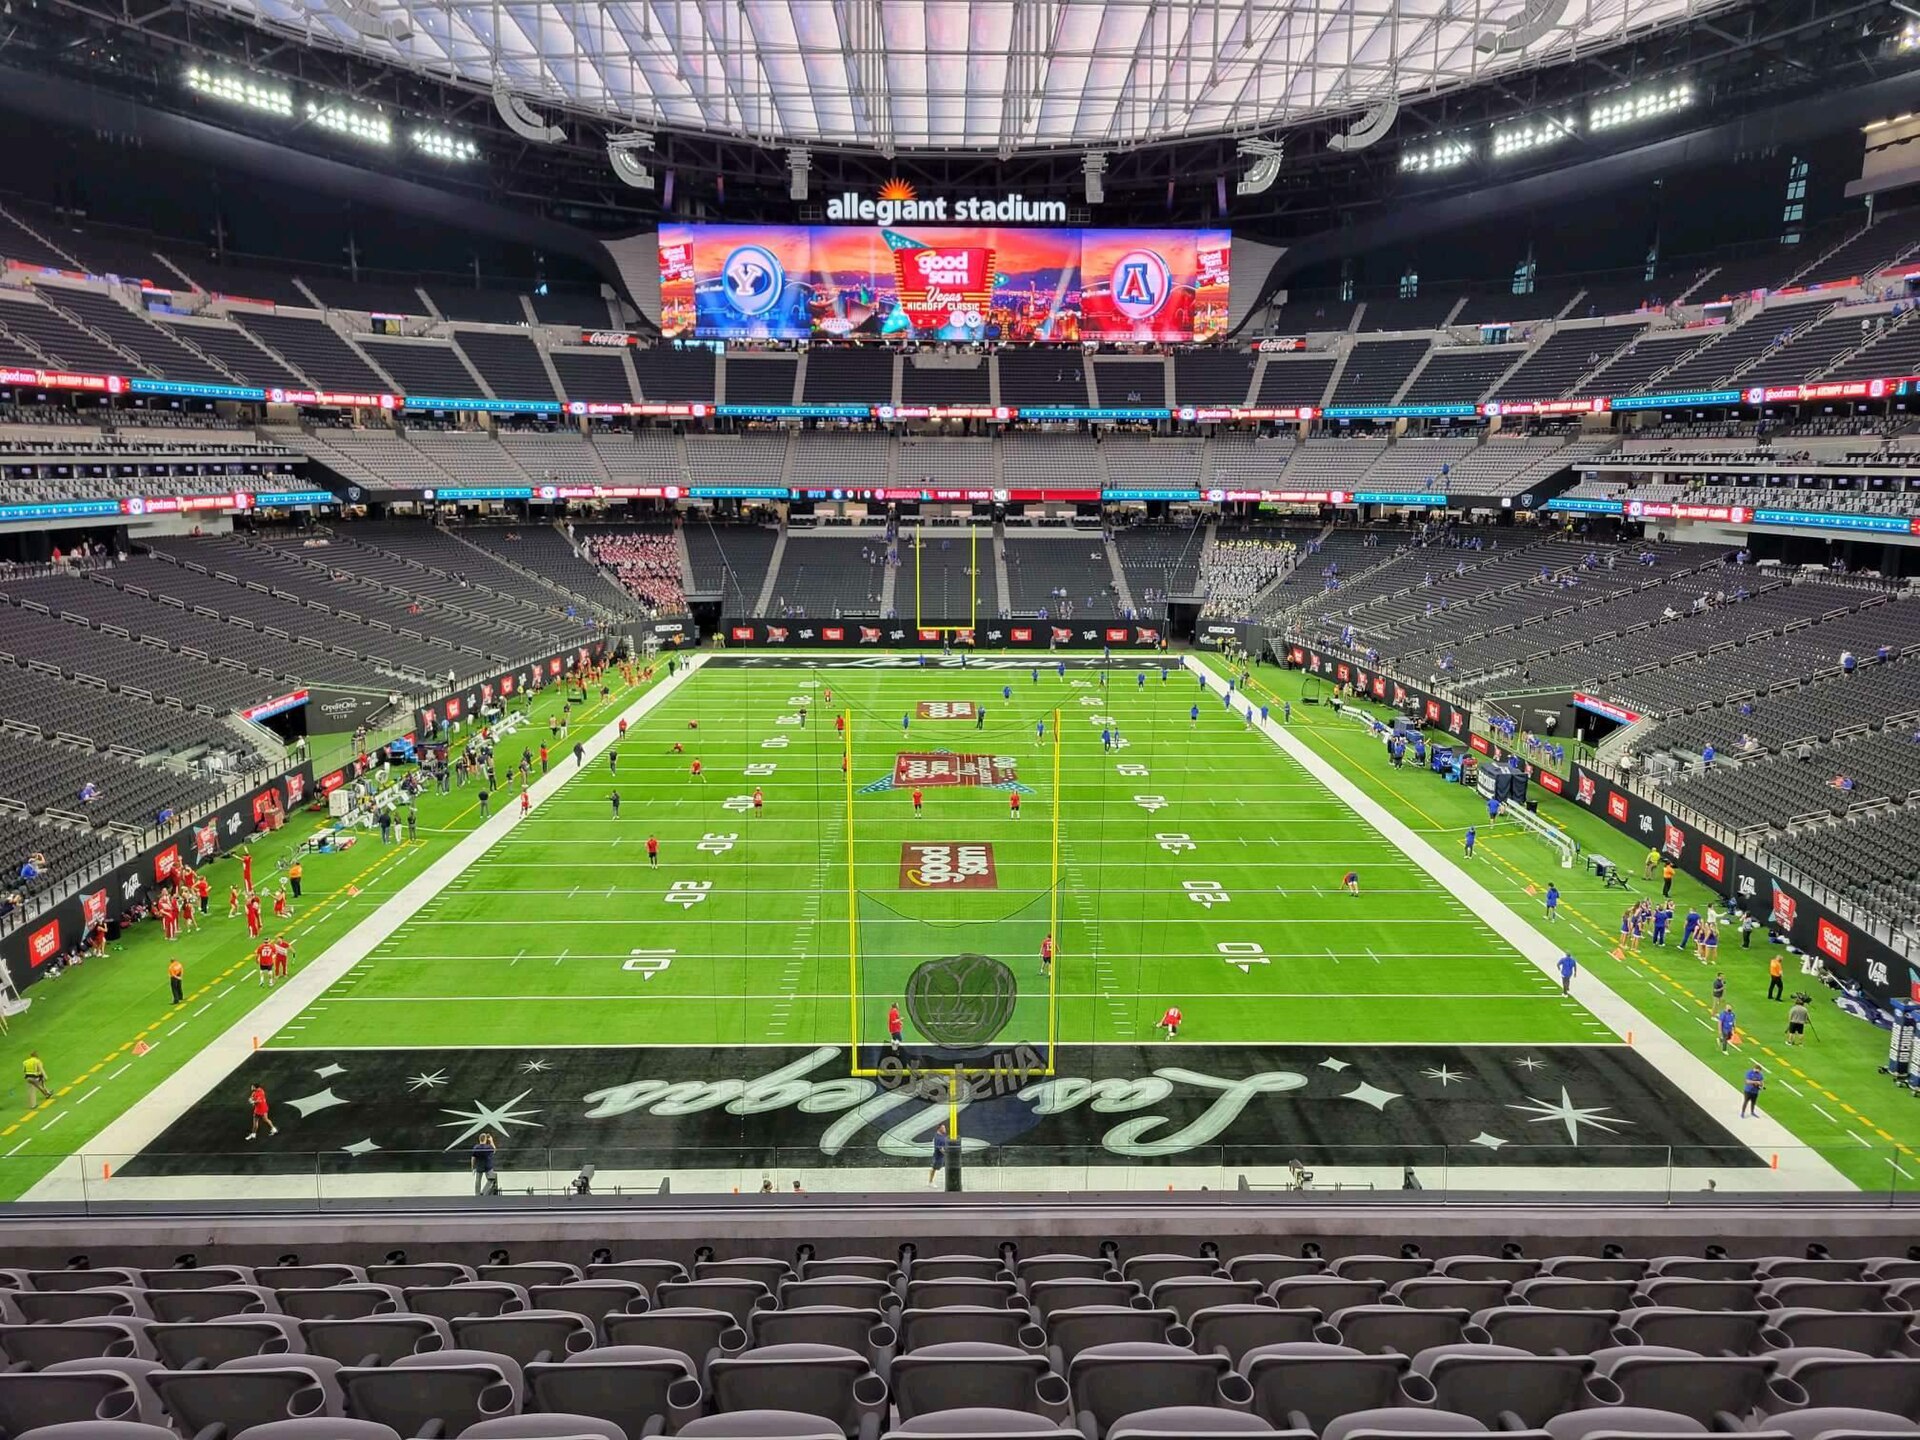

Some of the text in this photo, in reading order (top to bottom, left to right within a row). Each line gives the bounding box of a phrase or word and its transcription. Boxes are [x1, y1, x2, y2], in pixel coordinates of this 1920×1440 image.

[826, 192, 1066, 225] allegiant stadium
[917, 251, 968, 274] good
[928, 271, 968, 284] sam
[1118, 263, 1155, 305] A
[926, 287, 962, 302] Vegas
[907, 302, 980, 312] KICKOFF CLASSIC
[696, 833, 739, 850] 30
[1155, 833, 1197, 850] 30
[664, 881, 713, 902] 20
[1182, 881, 1231, 902] 20
[1823, 929, 1843, 947] good
[622, 949, 677, 970] 10
[1217, 943, 1271, 964] 10
[1018, 1066, 1309, 1158] Las
